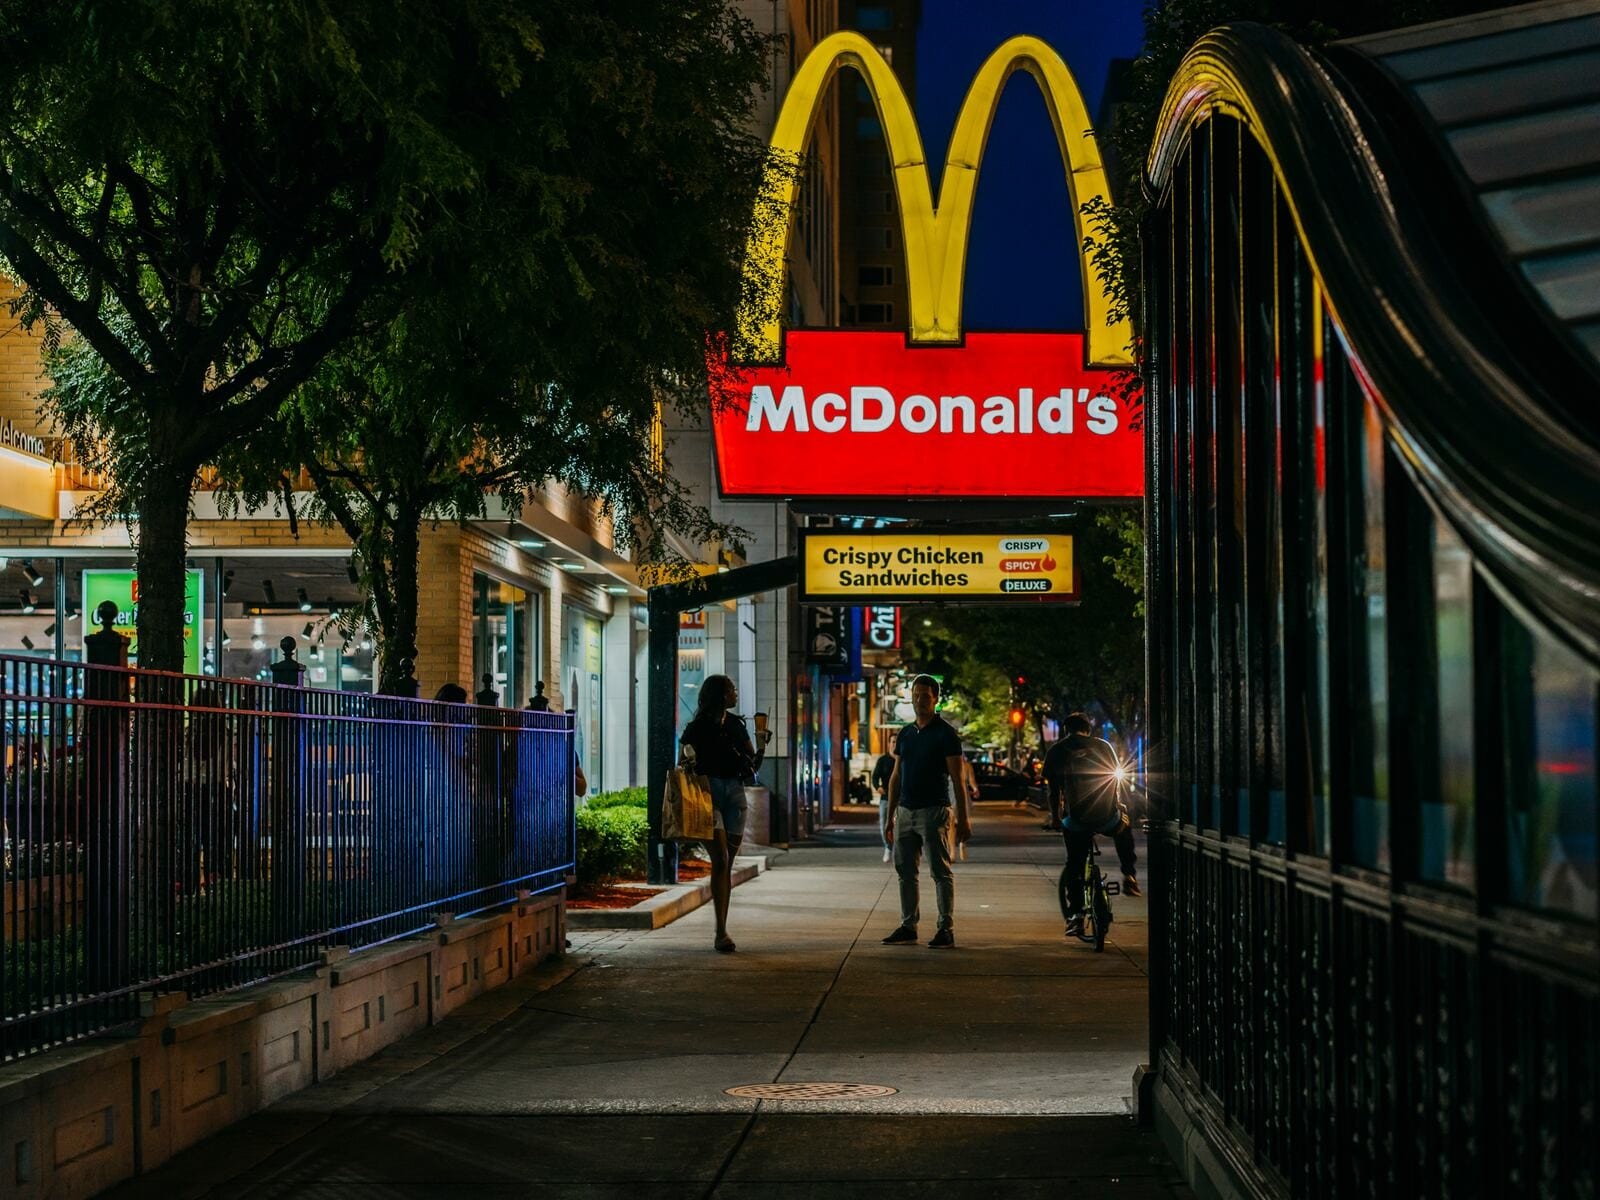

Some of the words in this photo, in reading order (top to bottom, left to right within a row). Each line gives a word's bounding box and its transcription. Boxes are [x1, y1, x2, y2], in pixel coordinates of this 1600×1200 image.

[746, 385, 1119, 435] McDonald's
[0, 416, 45, 456] elcome
[1005, 541, 1043, 550] CRISPY
[823, 547, 892, 568] Crispy
[897, 547, 983, 564] Chicken
[1005, 561, 1036, 571] SPICY
[839, 569, 969, 586] Sandwiches
[1005, 580, 1047, 590] DELUXE
